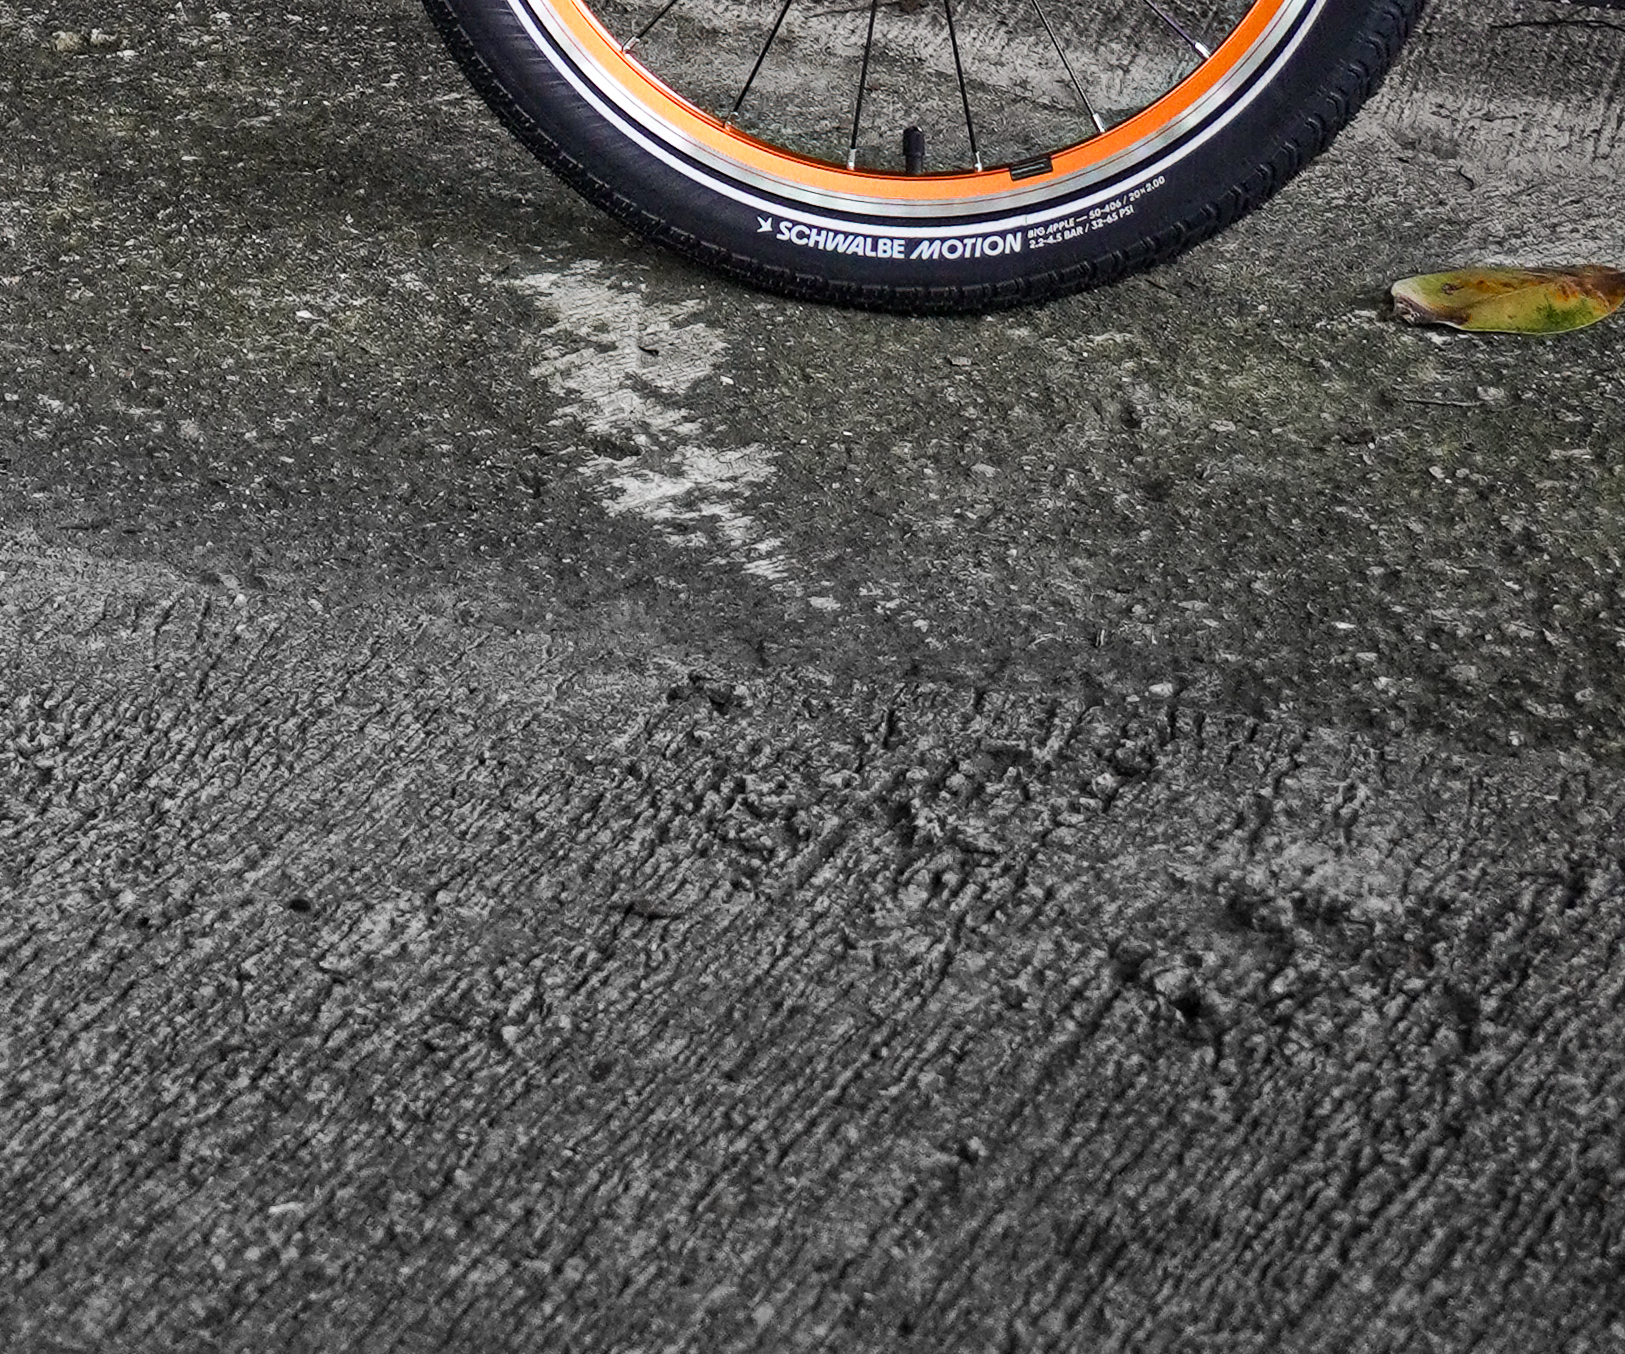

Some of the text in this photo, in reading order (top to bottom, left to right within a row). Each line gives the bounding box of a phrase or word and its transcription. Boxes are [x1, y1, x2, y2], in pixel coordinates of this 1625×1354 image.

[1046, 218, 1075, 235] APPLE
[1089, 200, 1122, 220] 50-406
[1064, 226, 1083, 240] BAR
[1119, 204, 1135, 218] PSI
[776, 221, 1023, 260] SCHWALBE MOTION
